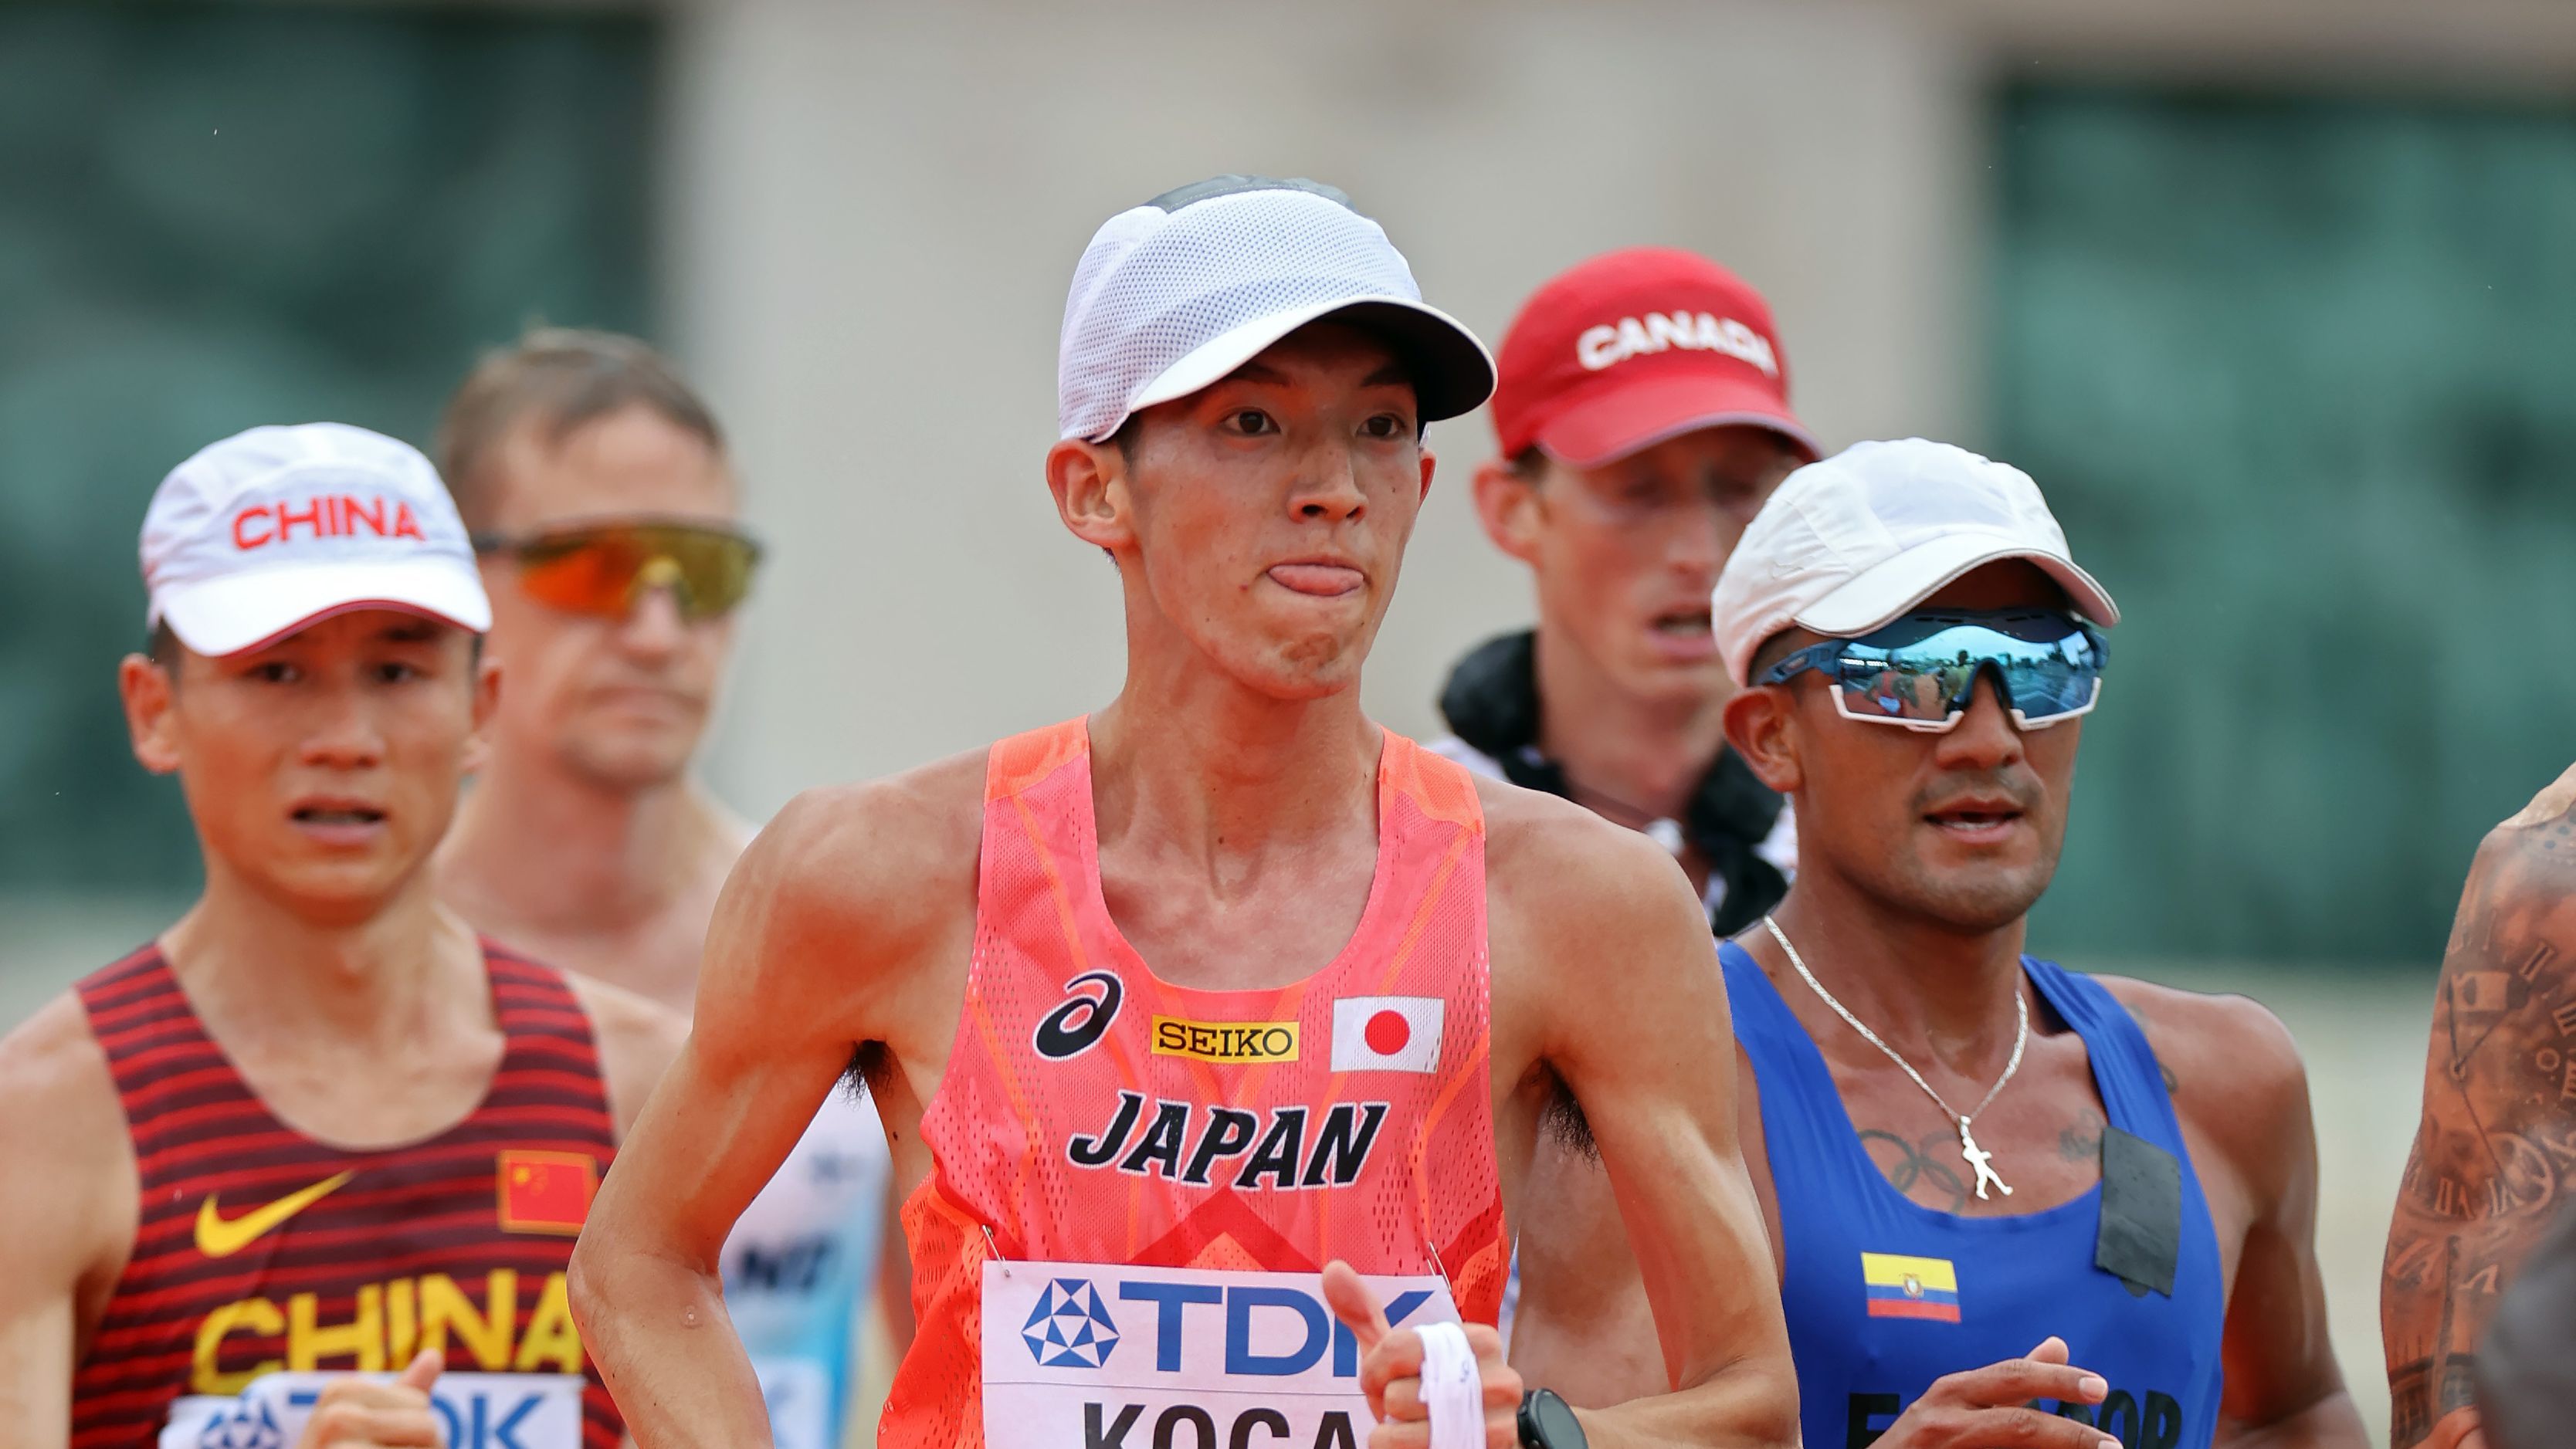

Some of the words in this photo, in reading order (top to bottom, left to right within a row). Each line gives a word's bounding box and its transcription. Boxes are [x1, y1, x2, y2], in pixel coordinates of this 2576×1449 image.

[1576, 310, 1779, 378] CANADA
[233, 495, 426, 550] CHINA
[1158, 1021, 1293, 1057] SEIKO
[1066, 1090, 1390, 1190] JAPAN
[192, 1267, 582, 1394] CHINA
